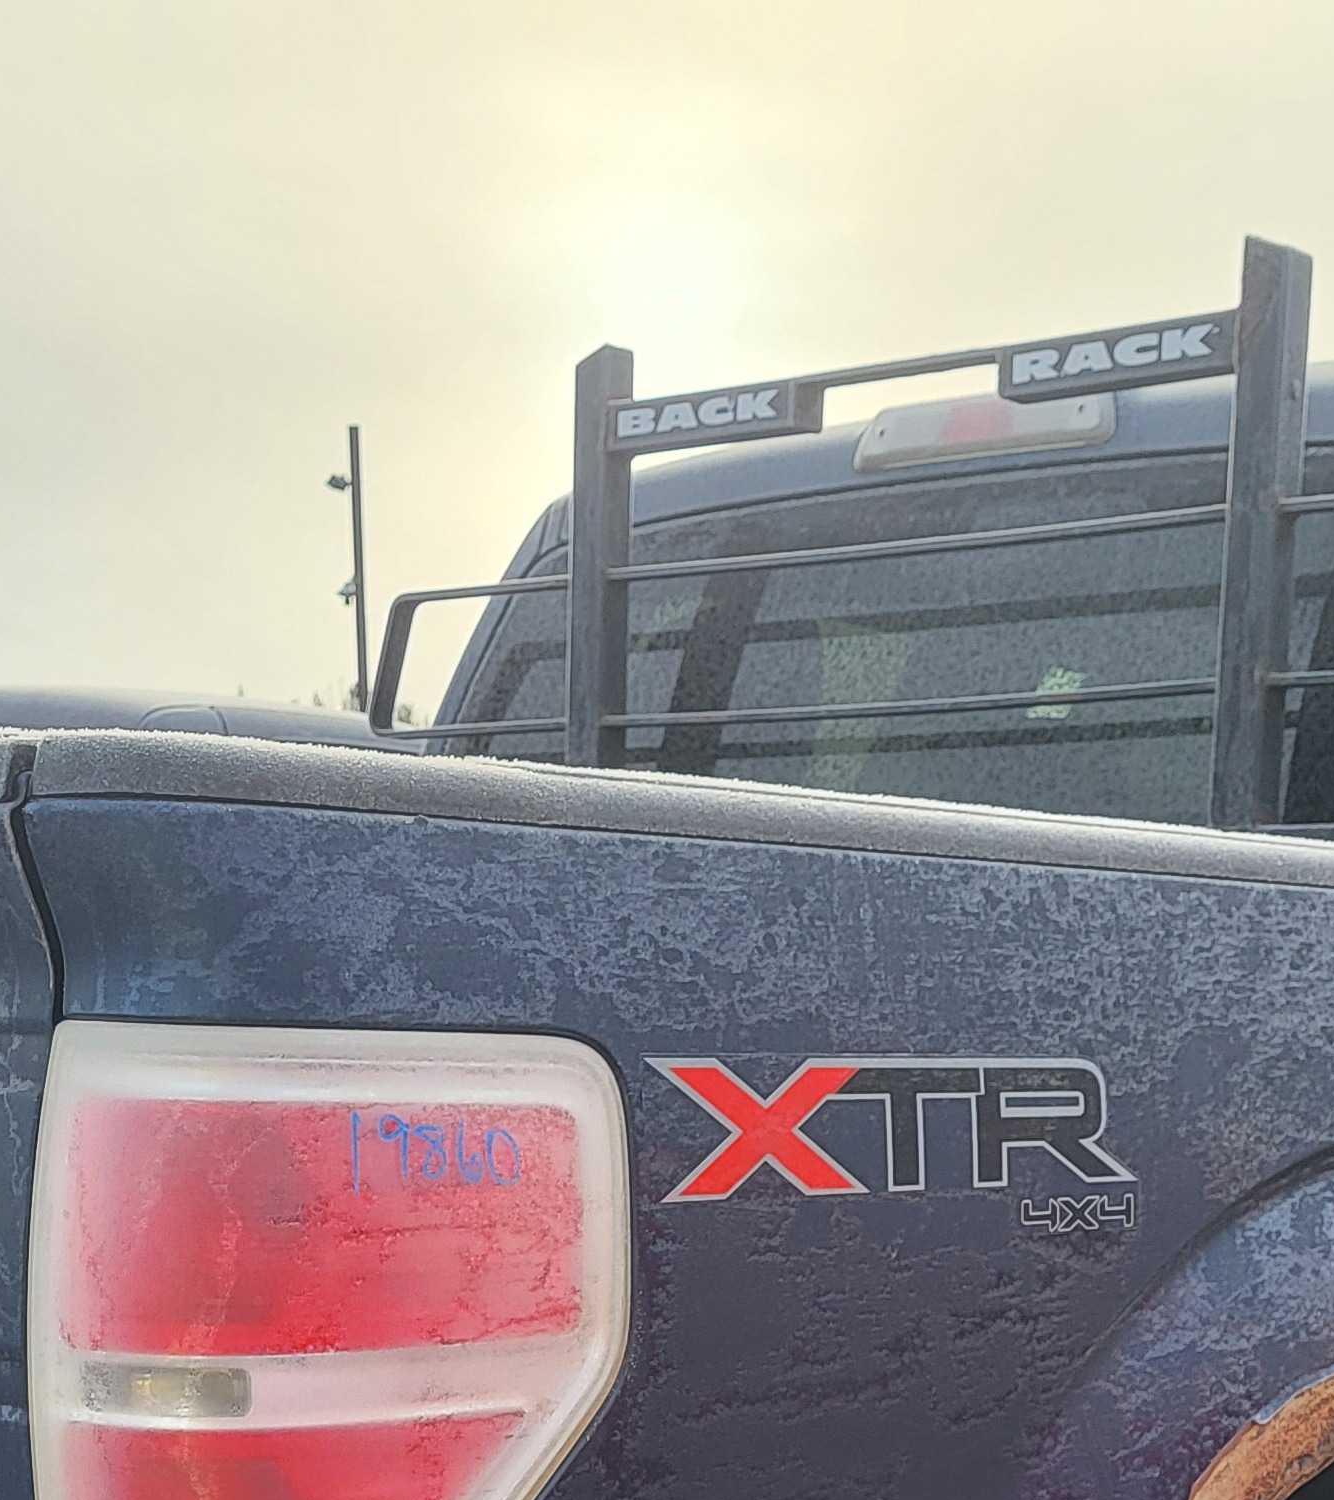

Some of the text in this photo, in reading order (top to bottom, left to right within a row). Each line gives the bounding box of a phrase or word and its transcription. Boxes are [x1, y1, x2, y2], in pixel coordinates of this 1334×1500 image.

[617, 323, 1214, 439] BACK RACK
[350, 1110, 522, 1199] 19860
[642, 1056, 1139, 1203] XTR
